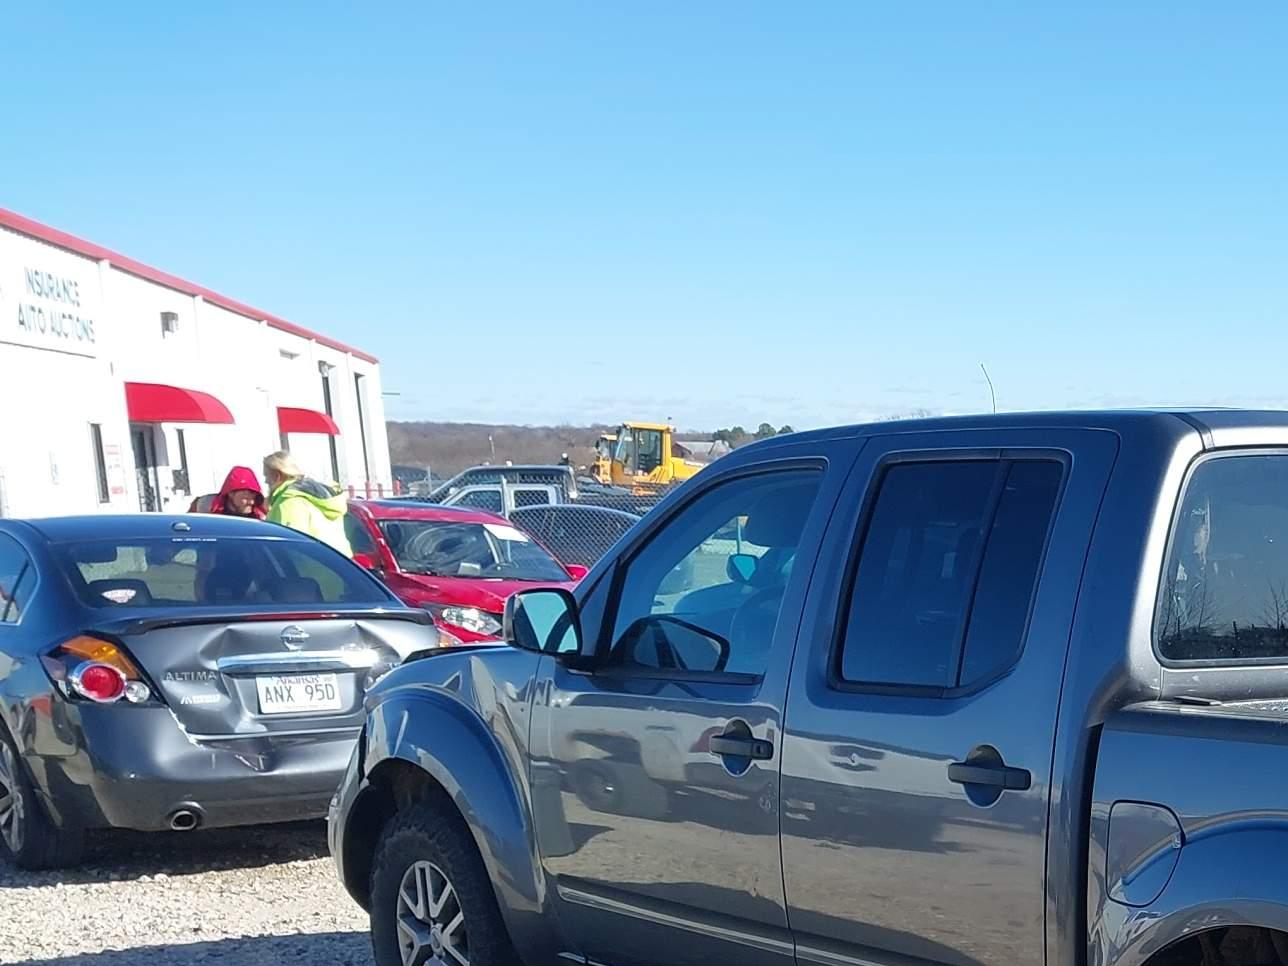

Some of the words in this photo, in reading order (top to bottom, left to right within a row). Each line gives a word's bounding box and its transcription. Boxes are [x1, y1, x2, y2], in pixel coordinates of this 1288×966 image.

[24, 266, 80, 307] INSURANCE
[18, 302, 46, 334] AUTO
[50, 309, 96, 344] AUCTIONS
[165, 671, 217, 681] ALTIMA
[264, 685, 295, 703] ANX
[304, 683, 335, 702] 95D
